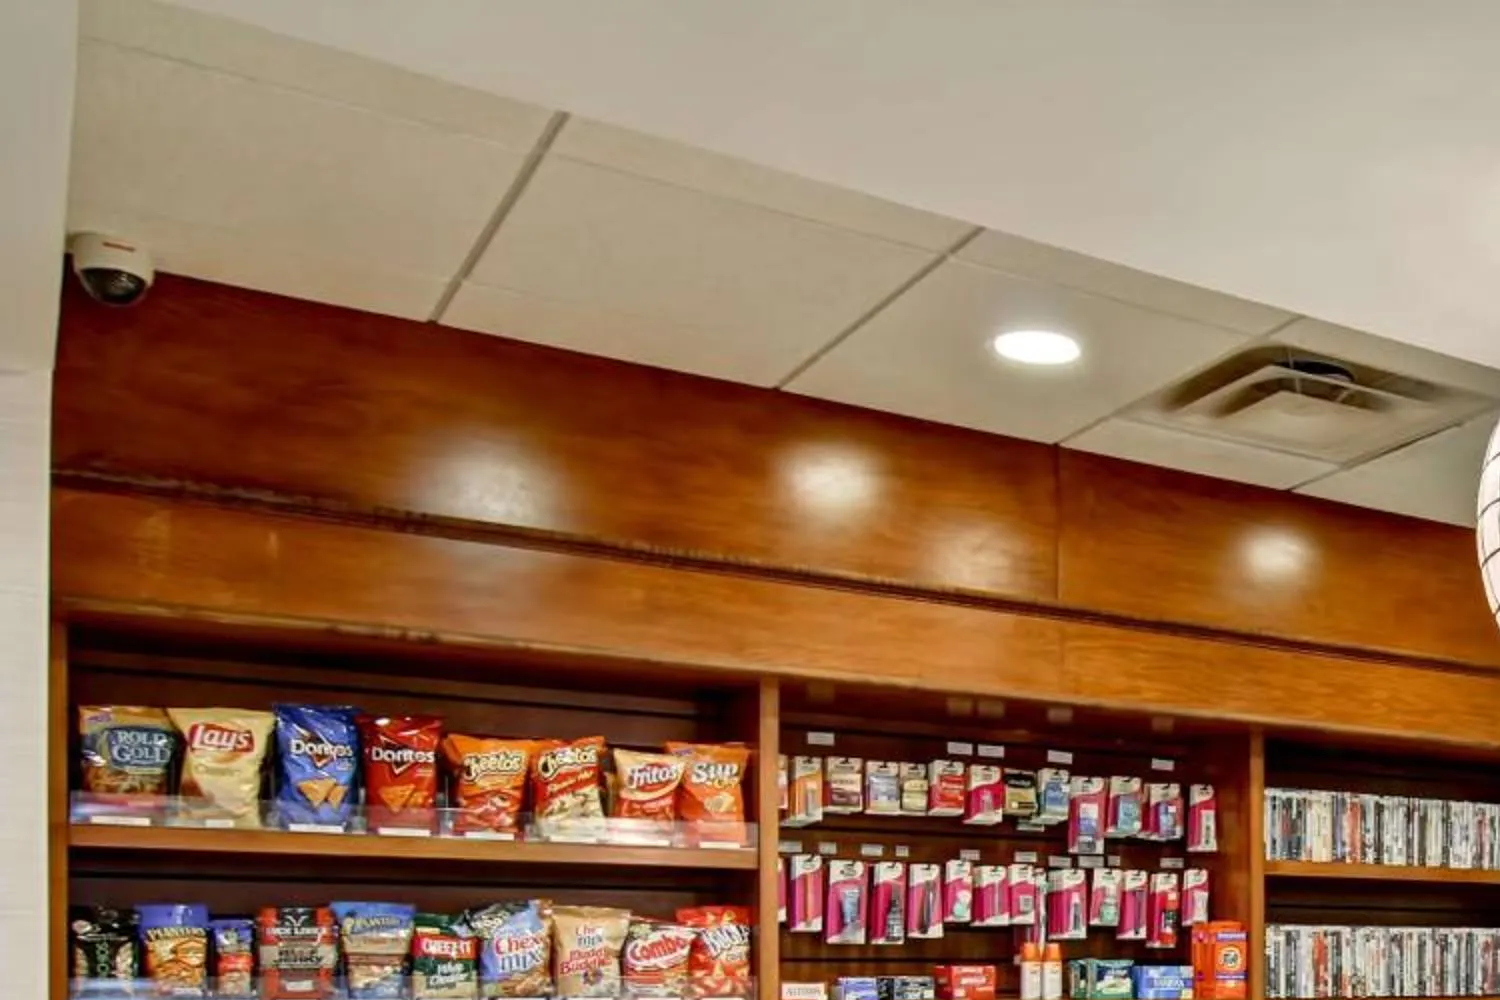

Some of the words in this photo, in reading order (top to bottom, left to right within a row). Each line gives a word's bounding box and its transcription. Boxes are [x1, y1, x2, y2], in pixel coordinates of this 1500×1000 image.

[112, 745, 171, 763] GOLD
[290, 738, 353, 758] Doritos
[371, 746, 435, 763] Doritos
[628, 763, 681, 789] Fritos
